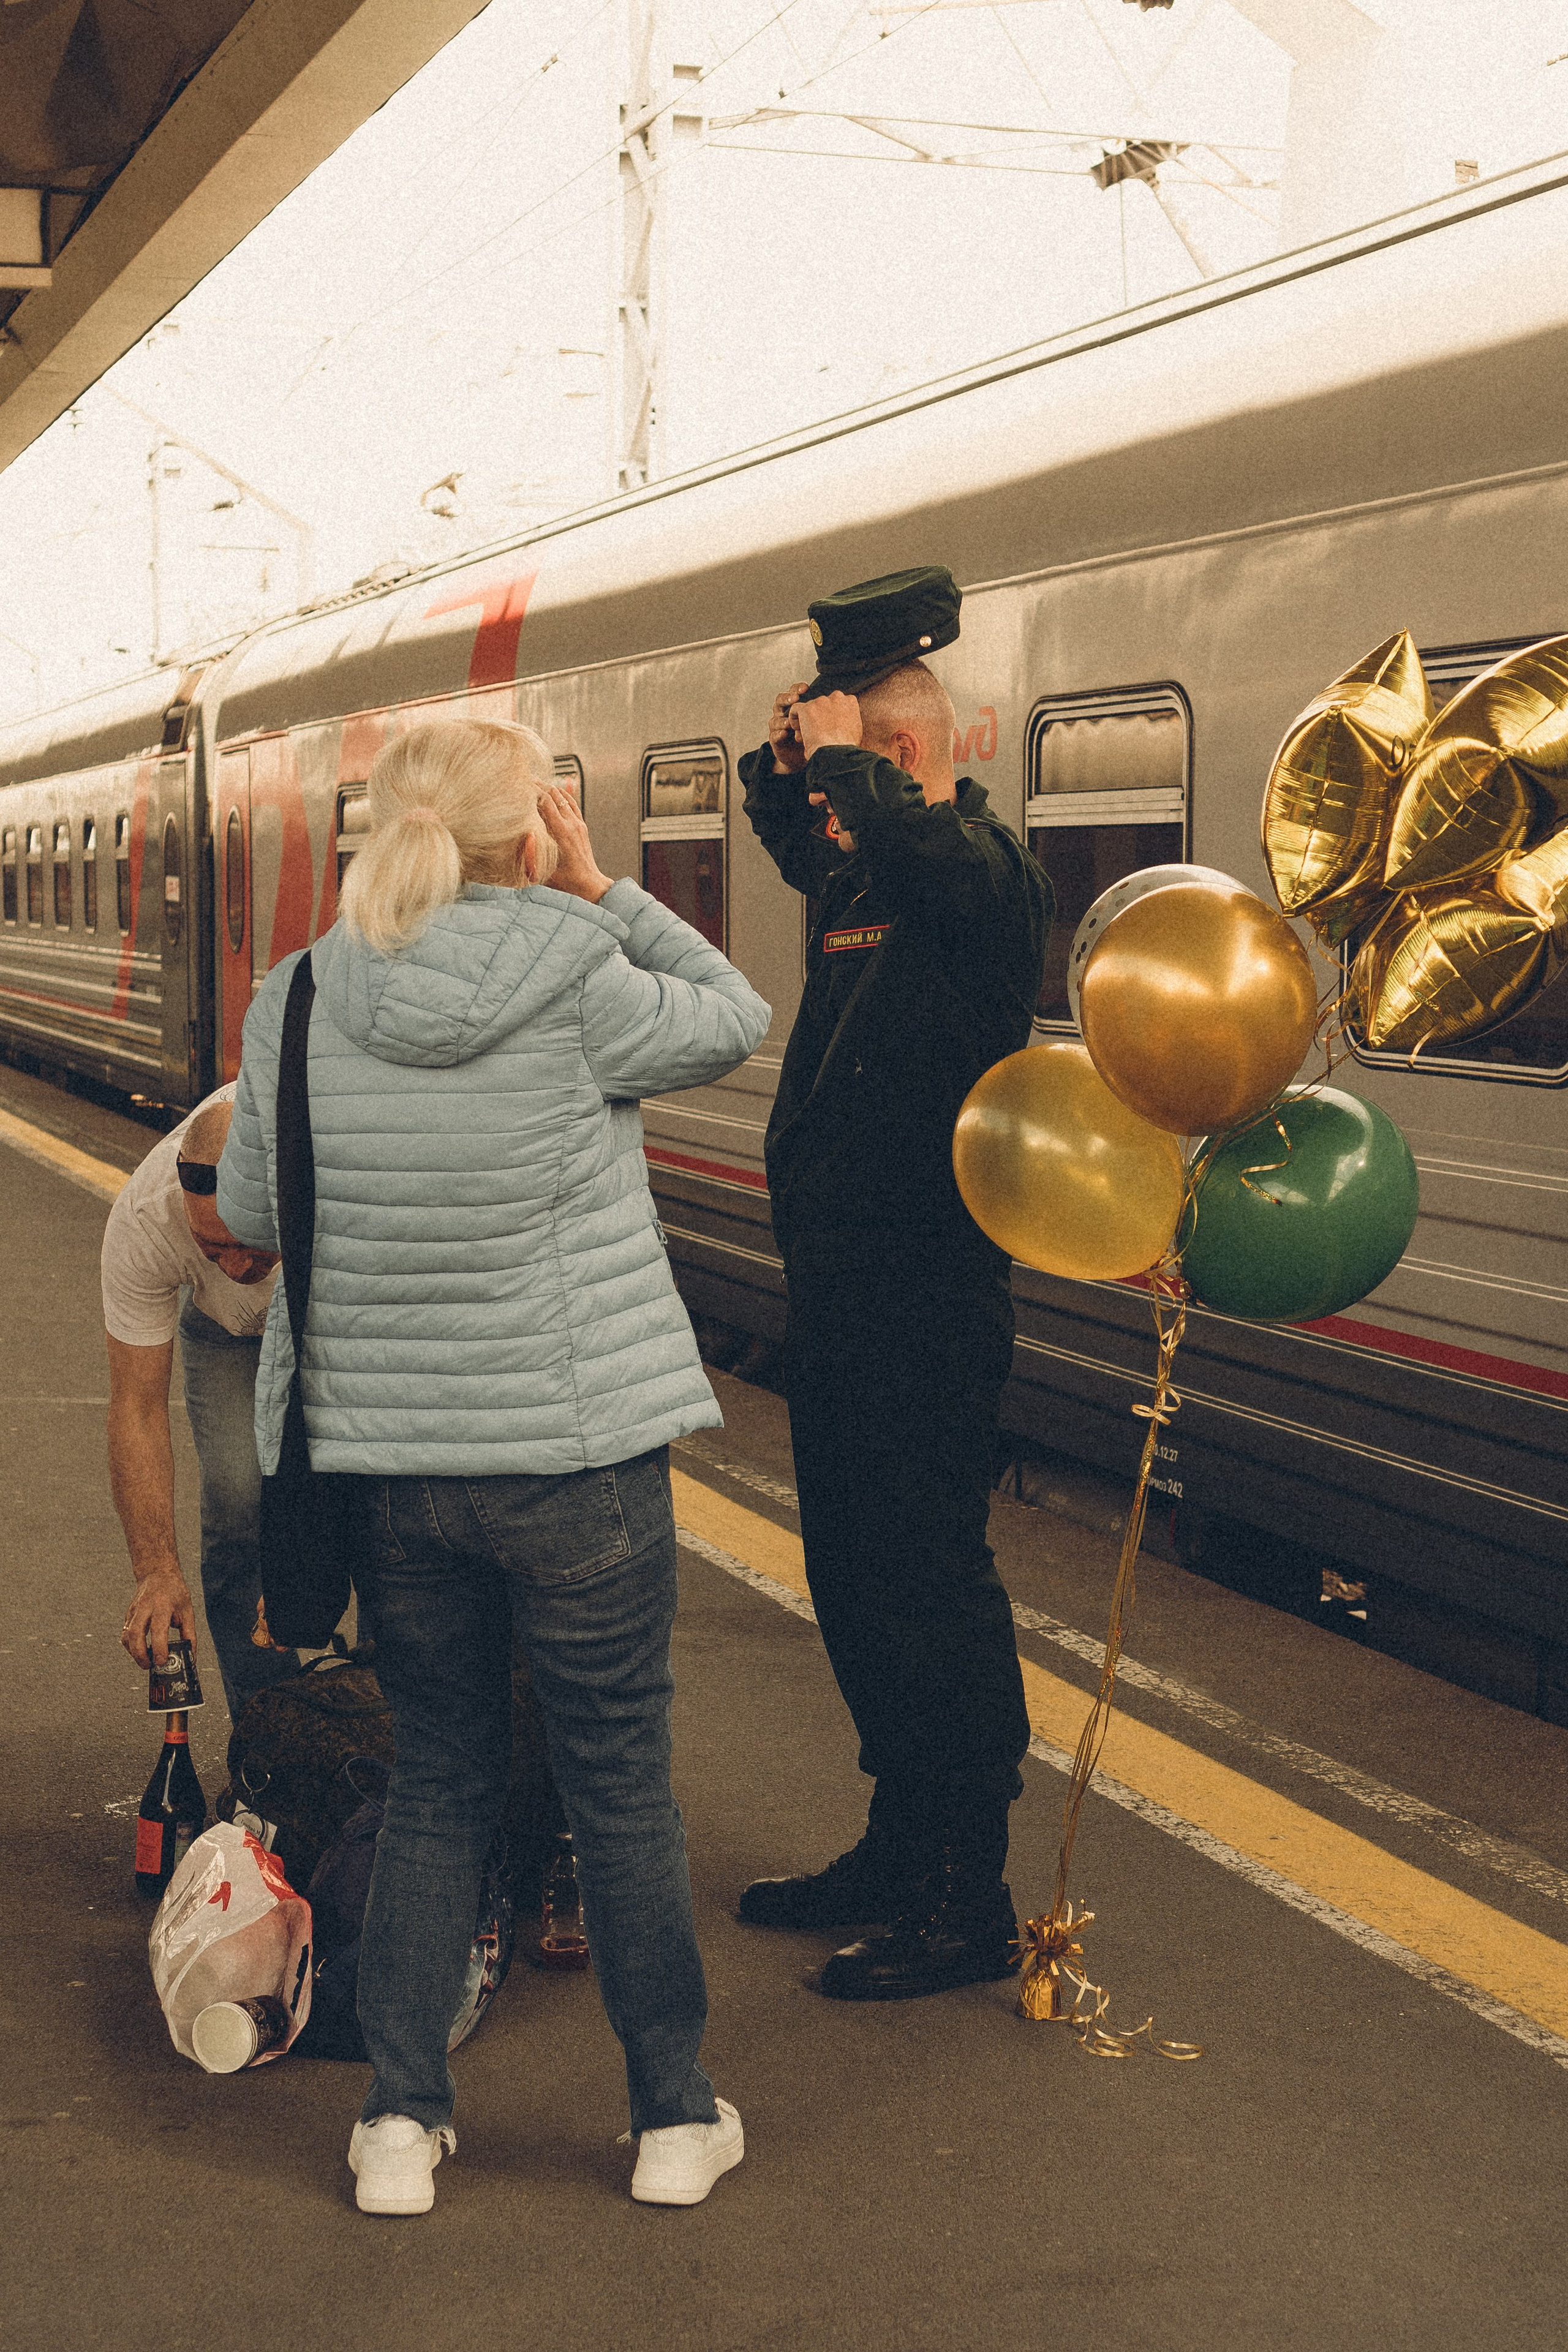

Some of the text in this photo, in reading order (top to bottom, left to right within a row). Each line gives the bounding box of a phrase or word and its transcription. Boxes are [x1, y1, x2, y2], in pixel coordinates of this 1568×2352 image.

[829, 932, 862, 948] ГОНСКИЙ
[1154, 1444, 1178, 1463] 0.12.27
[1147, 1476, 1183, 1498] ОРМОЗ 242
